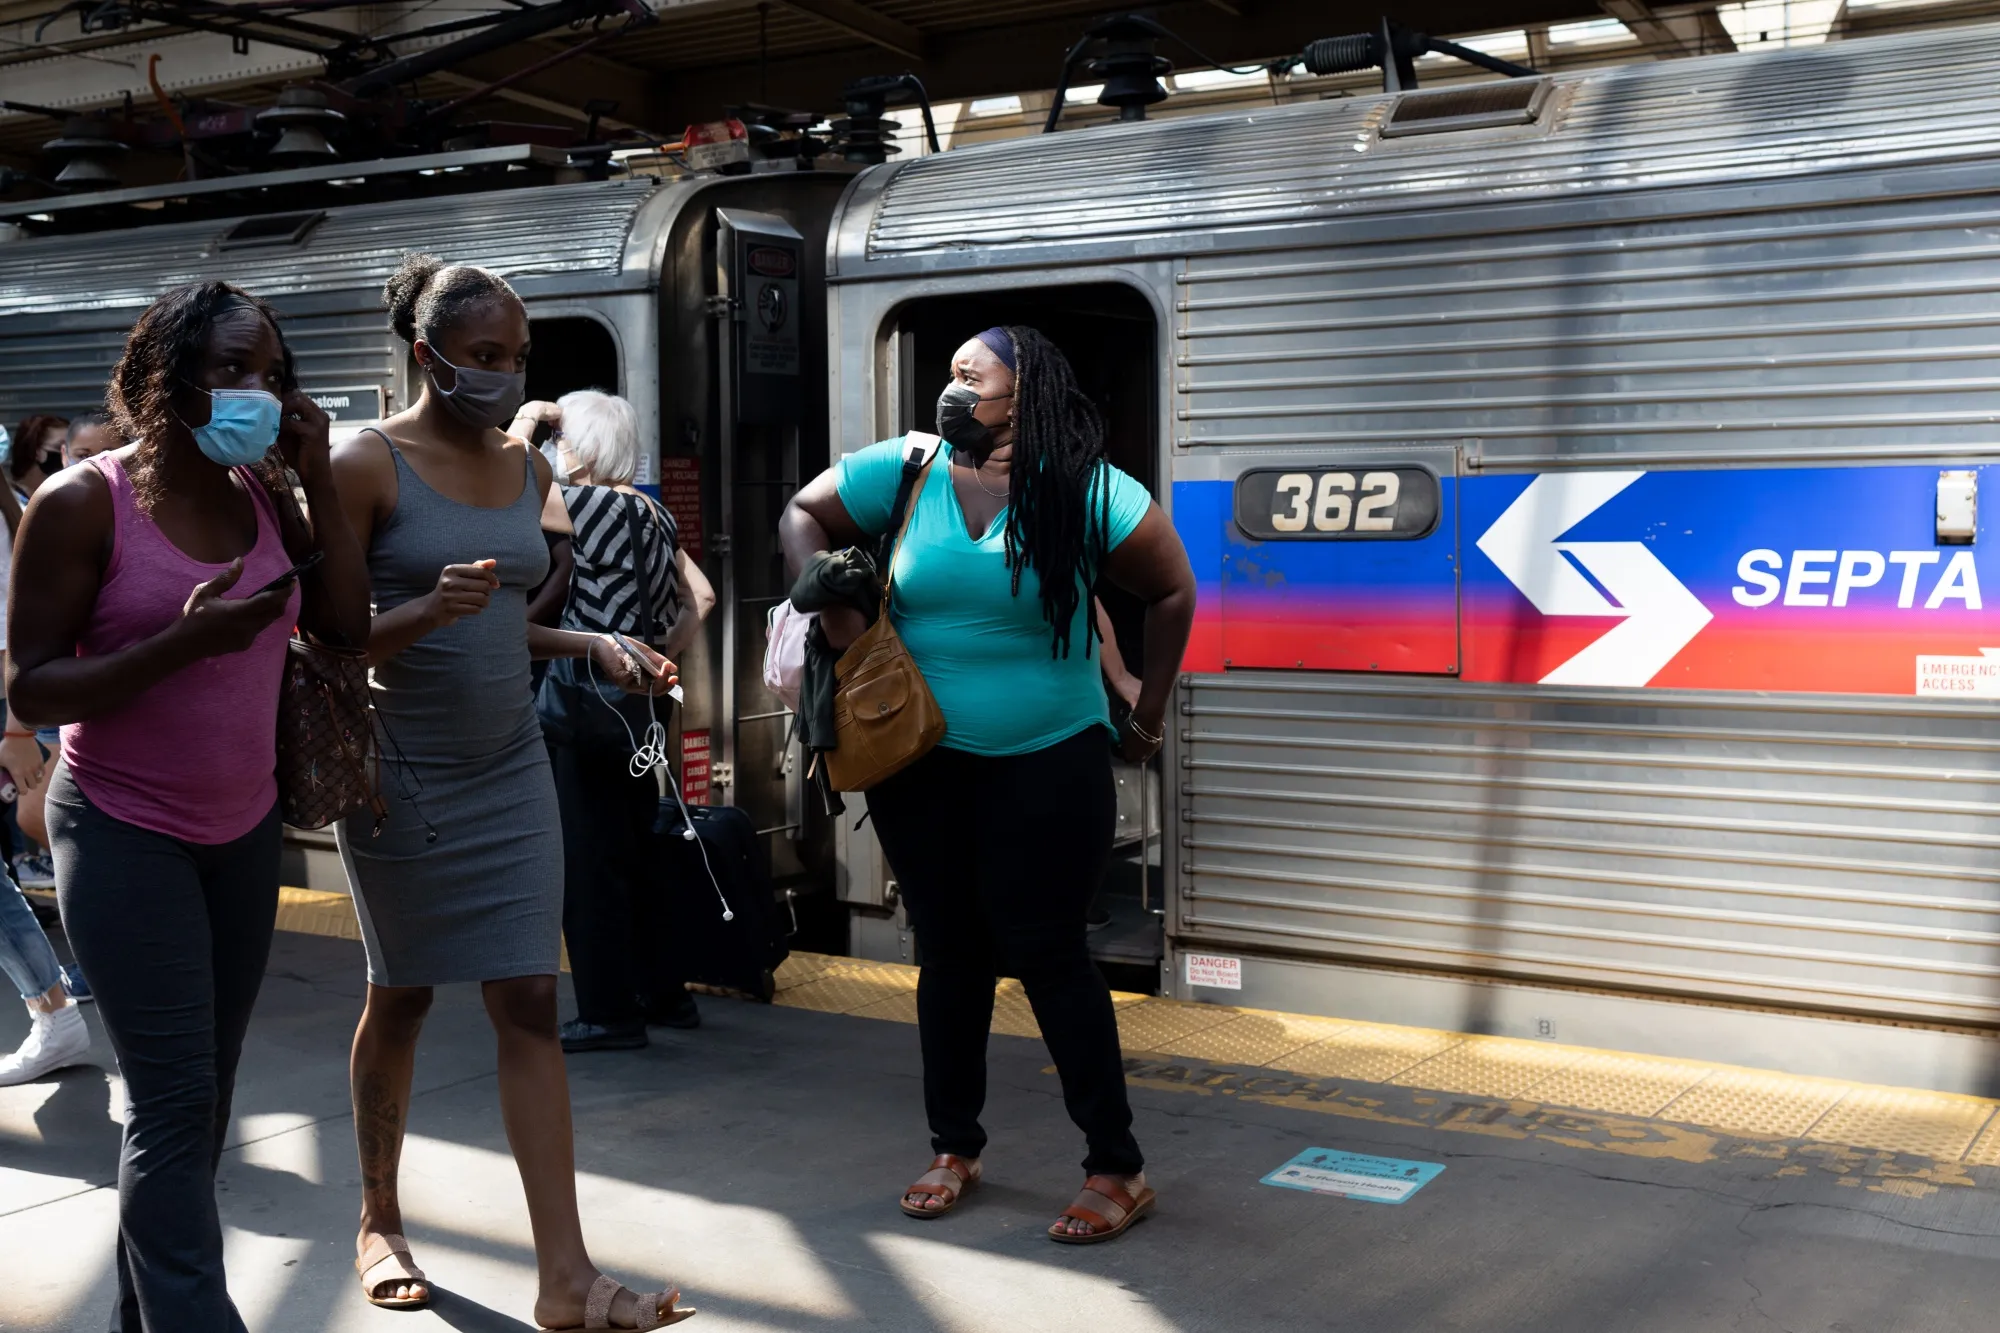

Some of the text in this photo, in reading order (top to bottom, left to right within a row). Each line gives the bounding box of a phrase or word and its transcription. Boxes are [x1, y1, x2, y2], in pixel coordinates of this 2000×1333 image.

[1272, 471, 1400, 531] 362
[1731, 548, 1983, 610] SEPTA
[1922, 663, 2000, 677] EMERGENC
[1922, 678, 1975, 691] ACCESS
[684, 736, 710, 750] DANGER
[1191, 955, 1237, 969] DANGER
[1190, 967, 1200, 975] Do
[1190, 975, 1217, 985] Moving
